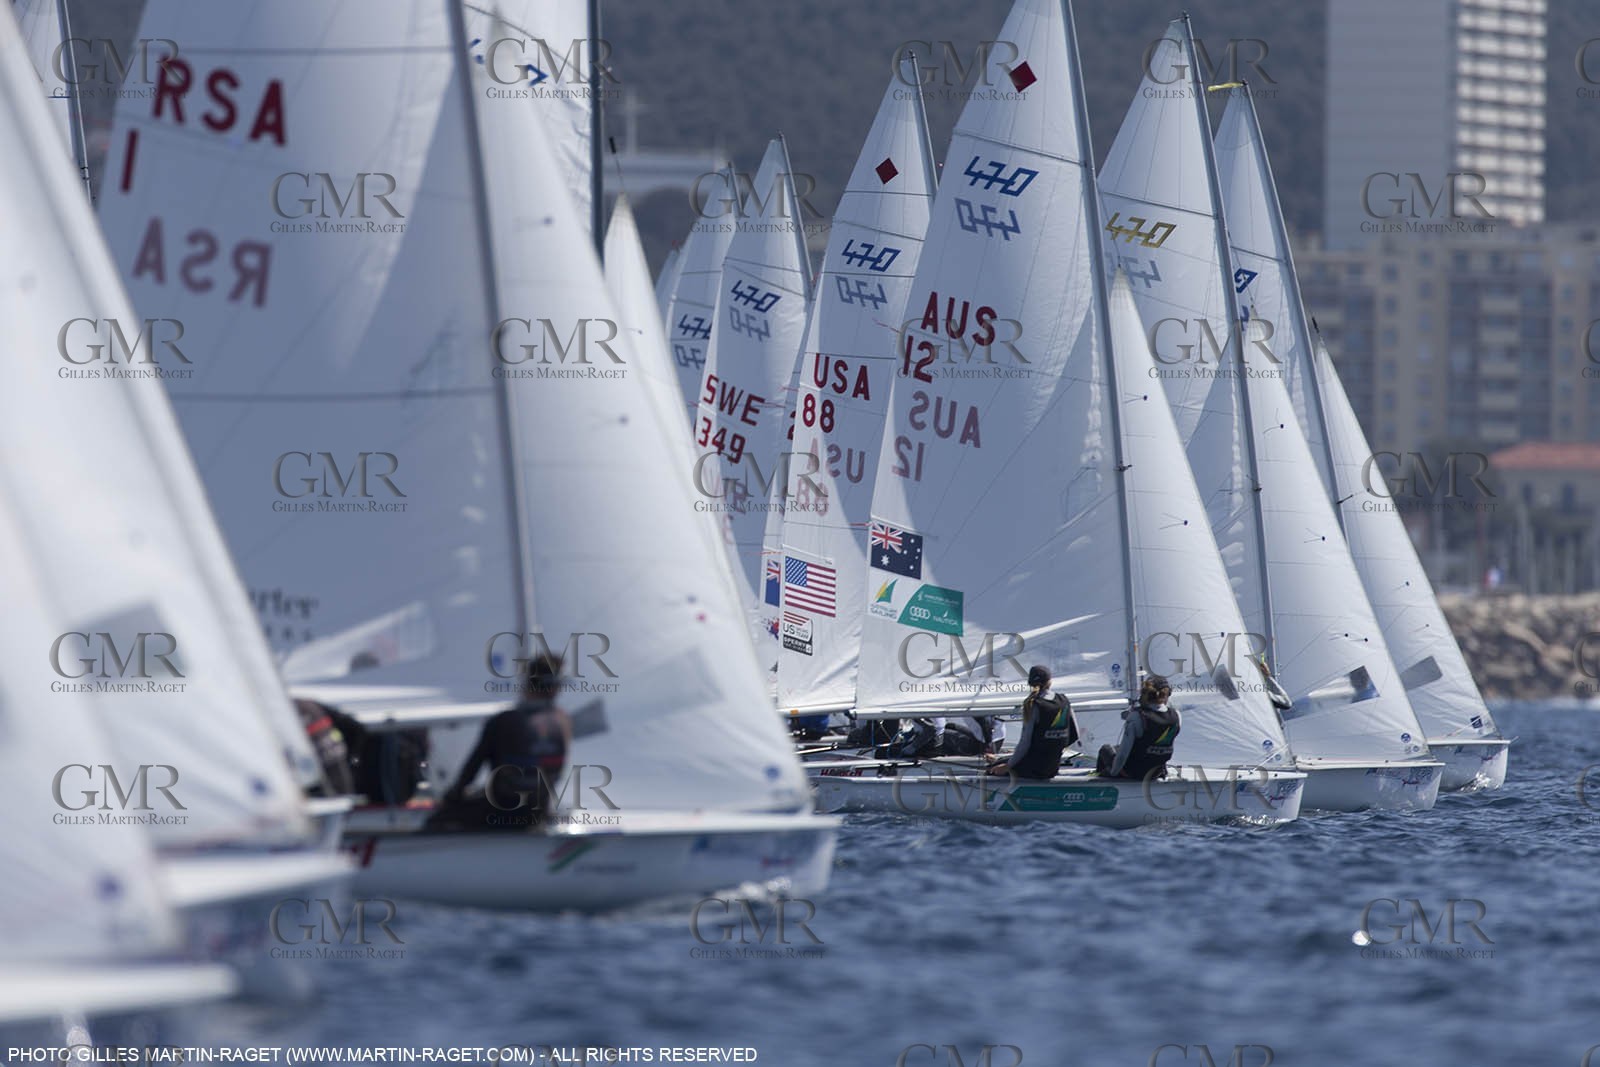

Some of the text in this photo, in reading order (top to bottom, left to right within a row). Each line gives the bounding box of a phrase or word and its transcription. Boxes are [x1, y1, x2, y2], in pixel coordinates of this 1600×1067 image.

[153, 55, 288, 147] RSA
[964, 156, 1039, 197] 470
[1105, 212, 1177, 248] 470
[842, 240, 901, 272] 470
[731, 280, 781, 313] 470
[920, 291, 998, 347] AUS
[813, 353, 871, 400] USA
[903, 335, 937, 384] 12
[703, 374, 765, 427] SWE
[802, 393, 835, 433] 88
[783, 623, 796, 635] US
